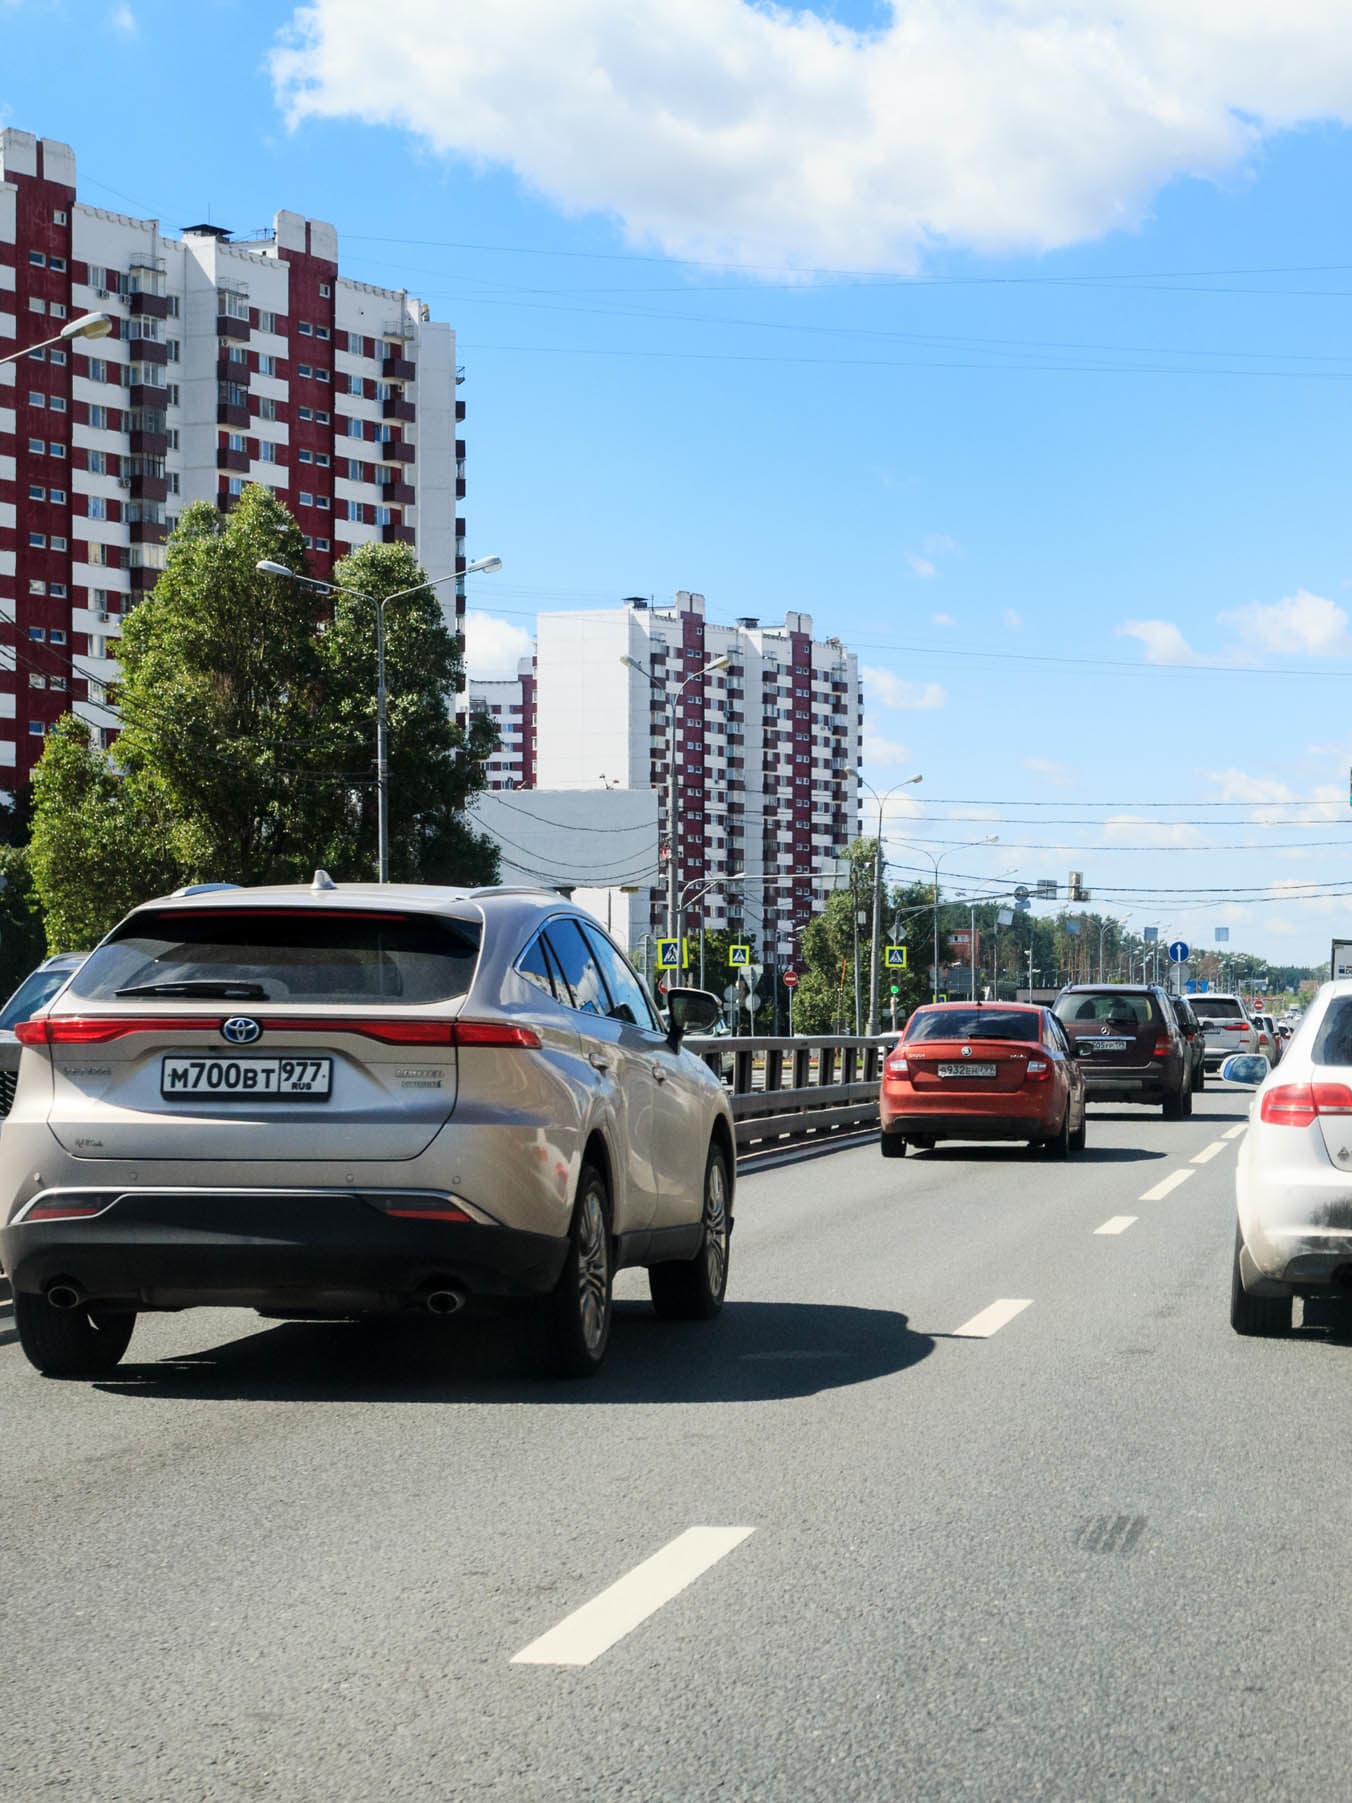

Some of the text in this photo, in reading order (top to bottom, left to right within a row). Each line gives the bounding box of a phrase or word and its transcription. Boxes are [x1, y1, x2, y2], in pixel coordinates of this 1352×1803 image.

[170, 1061, 322, 1089] М700ВТ 977
[291, 1082, 312, 1091] RUS
